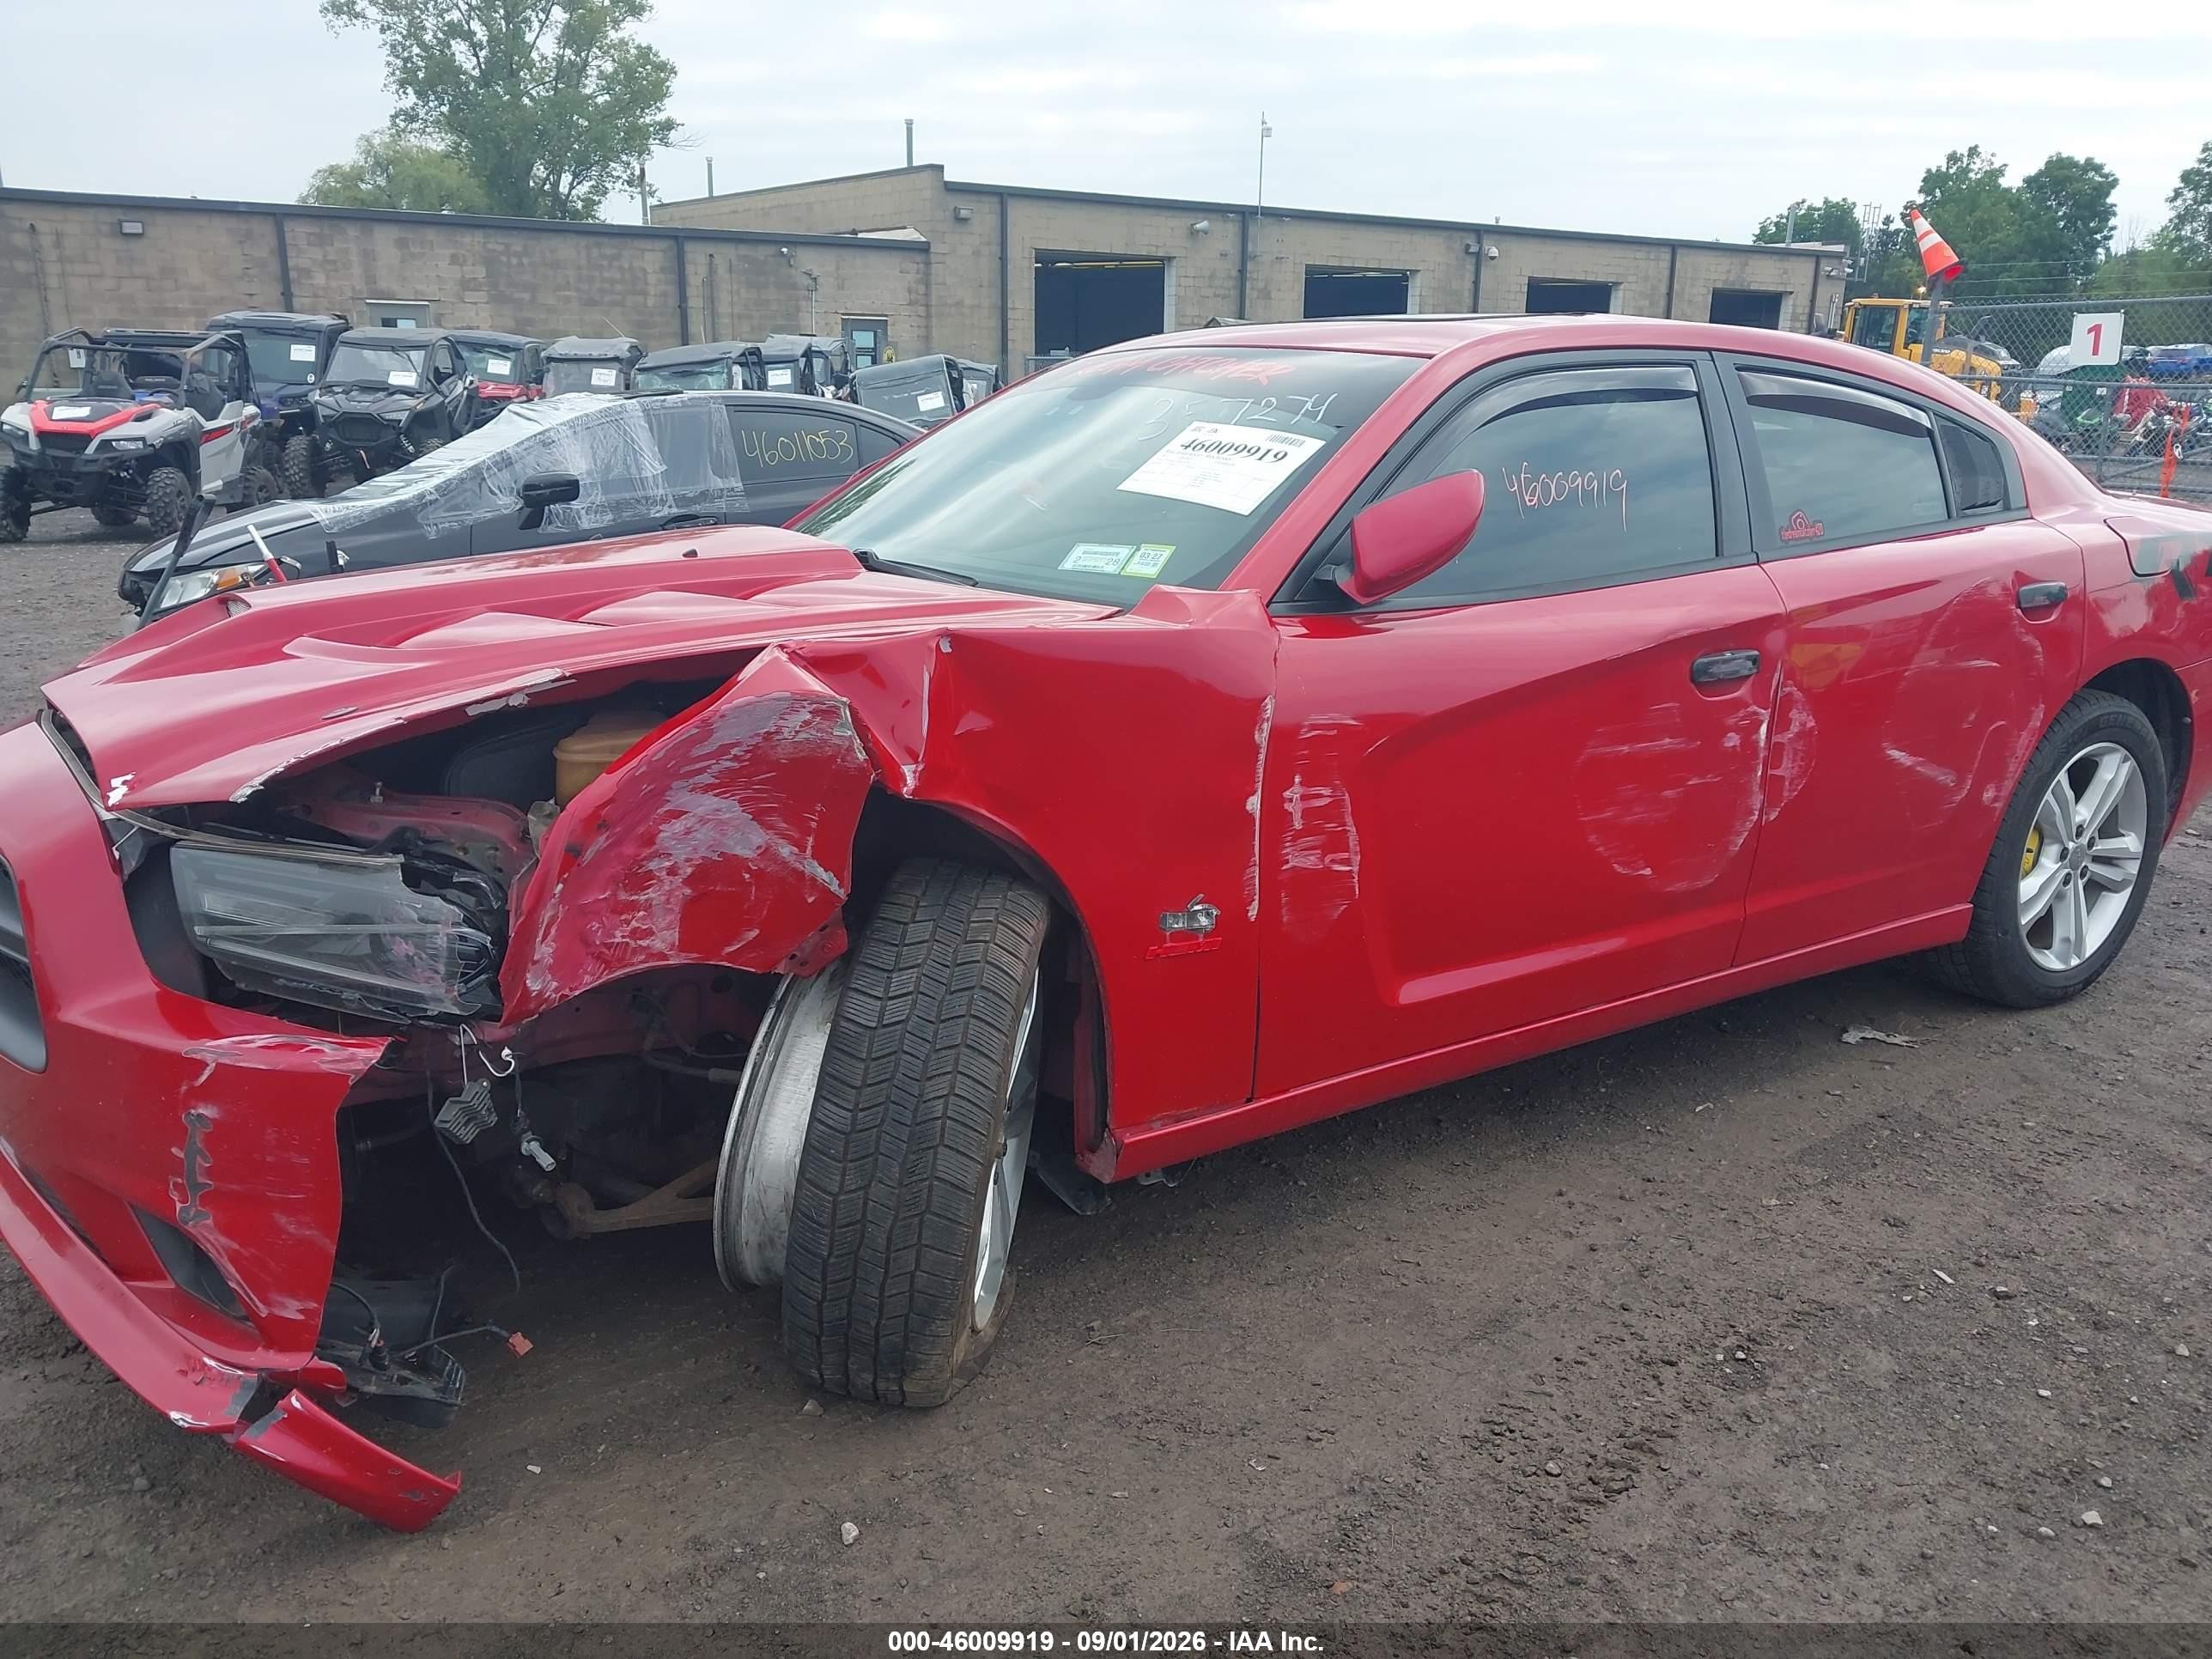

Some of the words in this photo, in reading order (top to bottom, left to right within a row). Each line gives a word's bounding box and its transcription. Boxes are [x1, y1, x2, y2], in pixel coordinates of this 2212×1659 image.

[2087, 323, 2103, 356] 1
[741, 429, 854, 468] 46011053
[1179, 438, 1289, 464] 46009919
[1502, 461, 1627, 533] 46009919
